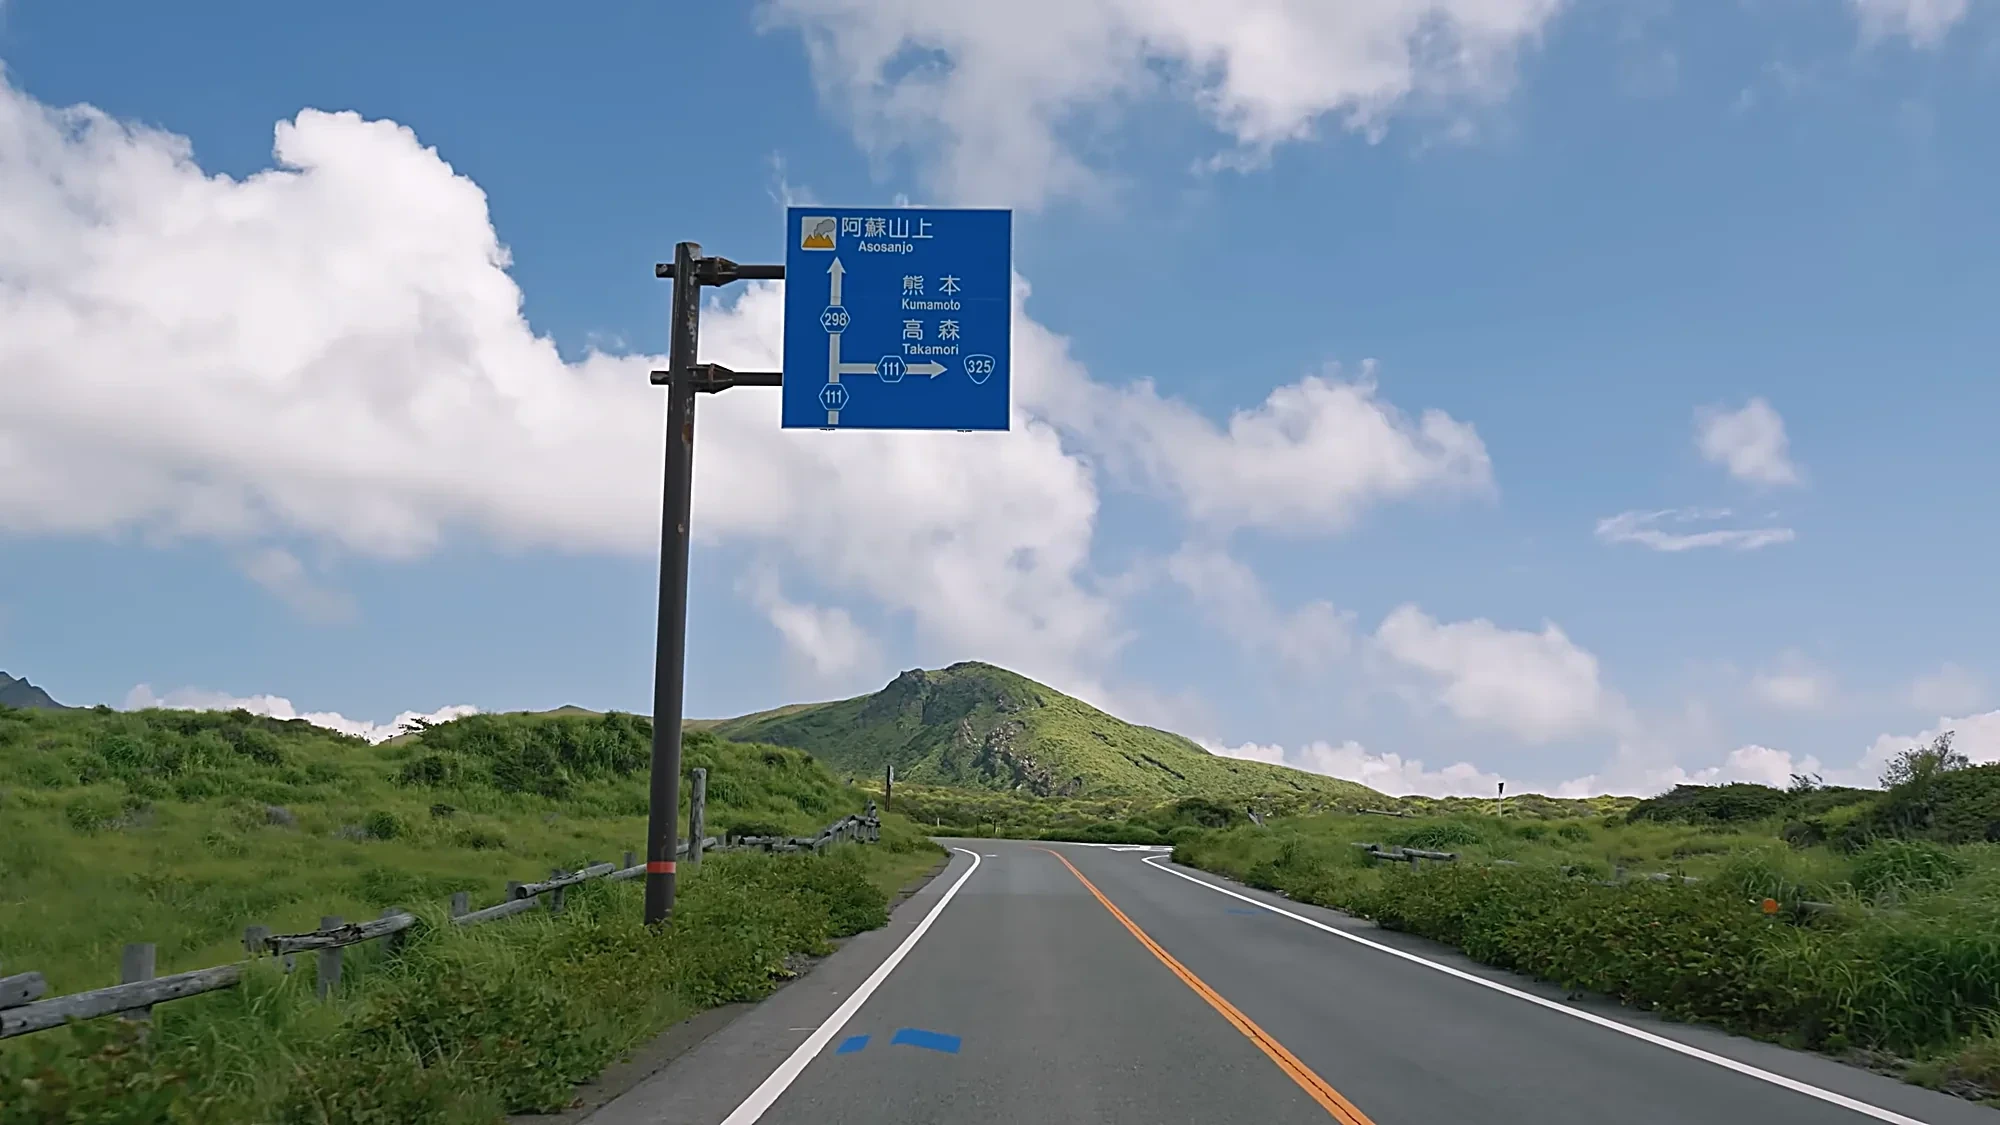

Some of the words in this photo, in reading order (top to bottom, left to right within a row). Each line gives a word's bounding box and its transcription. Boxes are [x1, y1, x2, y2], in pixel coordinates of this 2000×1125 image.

[841, 217, 934, 239] 阿蘇山上
[858, 240, 914, 255] Asosanjo
[902, 274, 961, 296] 熊本
[902, 298, 961, 311] Kumamoto
[824, 312, 847, 326] 298
[902, 318, 960, 341] 高森
[902, 343, 959, 355] Takamori
[882, 362, 899, 376] 111
[968, 360, 992, 374] 325
[825, 389, 842, 404] 111
